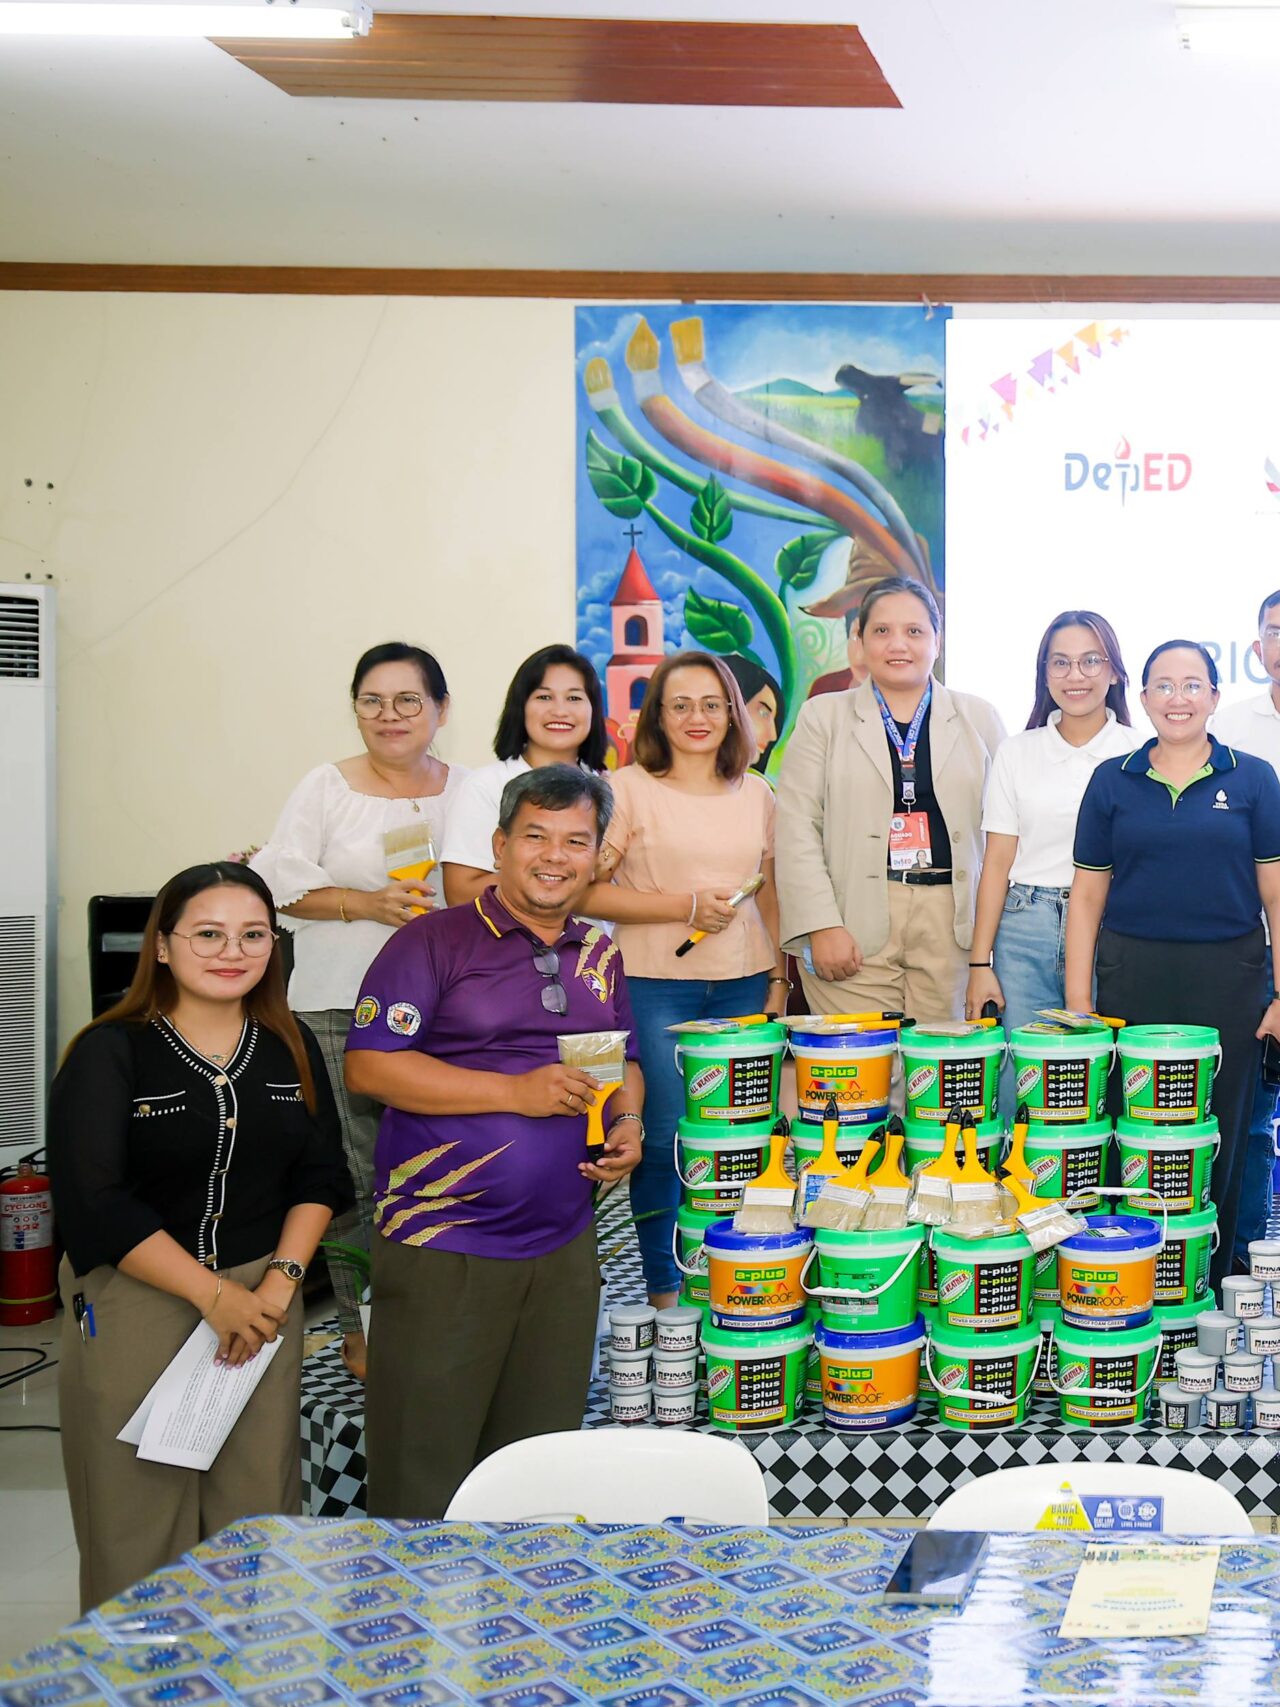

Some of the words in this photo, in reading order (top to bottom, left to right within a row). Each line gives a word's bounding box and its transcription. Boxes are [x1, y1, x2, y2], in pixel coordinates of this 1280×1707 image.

[735, 1060, 769, 1069] a-plus
[944, 1063, 980, 1071] a-plus
[1158, 1064, 1194, 1072] a-plus
[735, 1069, 769, 1078] a-plus
[811, 1068, 856, 1077] a-plus
[944, 1072, 980, 1080] a-plus
[1048, 1073, 1084, 1081] a-plus
[1158, 1073, 1194, 1081] a-plus
[735, 1078, 768, 1087] a-plus
[944, 1081, 979, 1089] a-plus
[1158, 1082, 1193, 1090] a-plus
[735, 1087, 768, 1096] a-plus
[944, 1090, 979, 1098] a-plus
[1158, 1091, 1192, 1099] a-plus
[734, 1096, 767, 1105] a-plus
[1048, 1099, 1083, 1107] a-plus
[1158, 1099, 1192, 1107] a-plus
[720, 1153, 757, 1162] a-plus
[1068, 1151, 1099, 1159] a-plus
[1153, 1154, 1189, 1162] a-plus
[720, 1163, 757, 1171] a-plus
[1067, 1159, 1098, 1169] a-plus
[720, 1171, 757, 1179] a-plus
[1067, 1169, 1098, 1177] a-plus
[1153, 1172, 1189, 1180] a-plus
[1067, 1177, 1097, 1186] a-plus
[1153, 1181, 1188, 1189] a-plus
[4, 1202, 48, 1212] CYCLONE
[736, 1270, 784, 1280] a-plus
[980, 1267, 1018, 1276] a-plus
[1072, 1270, 1116, 1281] a-plus
[980, 1276, 1017, 1285] a-plus
[980, 1285, 1016, 1295] a-plus
[727, 1292, 792, 1305] POWERROOF
[980, 1294, 1016, 1304] a-plus
[1067, 1292, 1126, 1306] POWERROOF
[980, 1303, 1015, 1314] a-plus
[1163, 1331, 1196, 1341] a-plus
[1163, 1341, 1196, 1351] a-plus
[741, 1362, 780, 1372] a-plus
[974, 1361, 1013, 1371] a-plus
[1095, 1361, 1133, 1370] a-plus
[741, 1372, 780, 1381] a-plus
[829, 1368, 871, 1378] a-plus
[974, 1371, 1012, 1381] a-plus
[1095, 1371, 1133, 1379] a-plus
[741, 1381, 780, 1390] a-plus
[974, 1380, 1012, 1390] a-plus
[1095, 1379, 1132, 1389] a-plus
[741, 1390, 779, 1399] a-plus
[825, 1390, 881, 1403] POWERROOF
[741, 1399, 779, 1409] a-plus
[1095, 1398, 1131, 1407] a-plus
